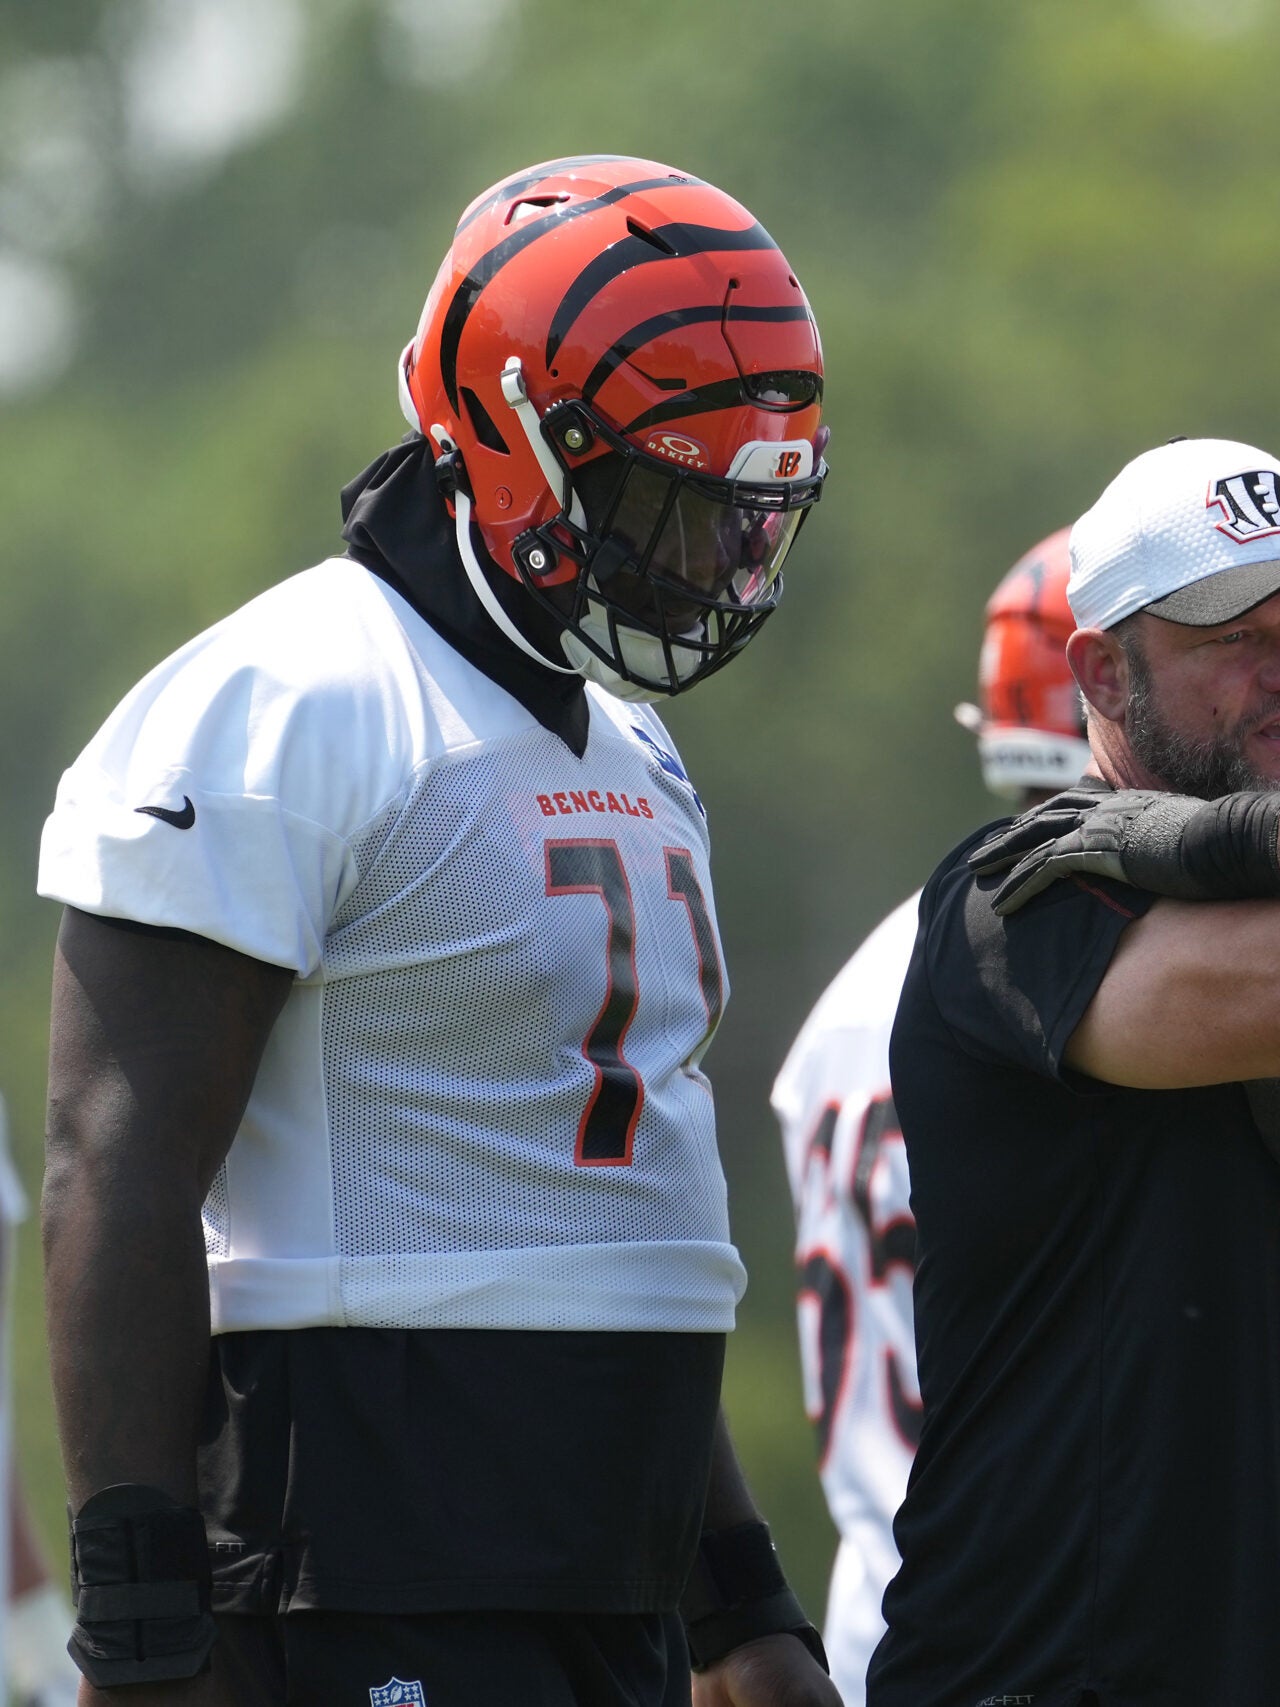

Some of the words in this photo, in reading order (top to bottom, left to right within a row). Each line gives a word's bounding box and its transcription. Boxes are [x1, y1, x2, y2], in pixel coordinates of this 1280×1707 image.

[647, 441, 705, 468] OAKLEY
[536, 789, 654, 819] BENGALS
[544, 838, 723, 1167] 71
